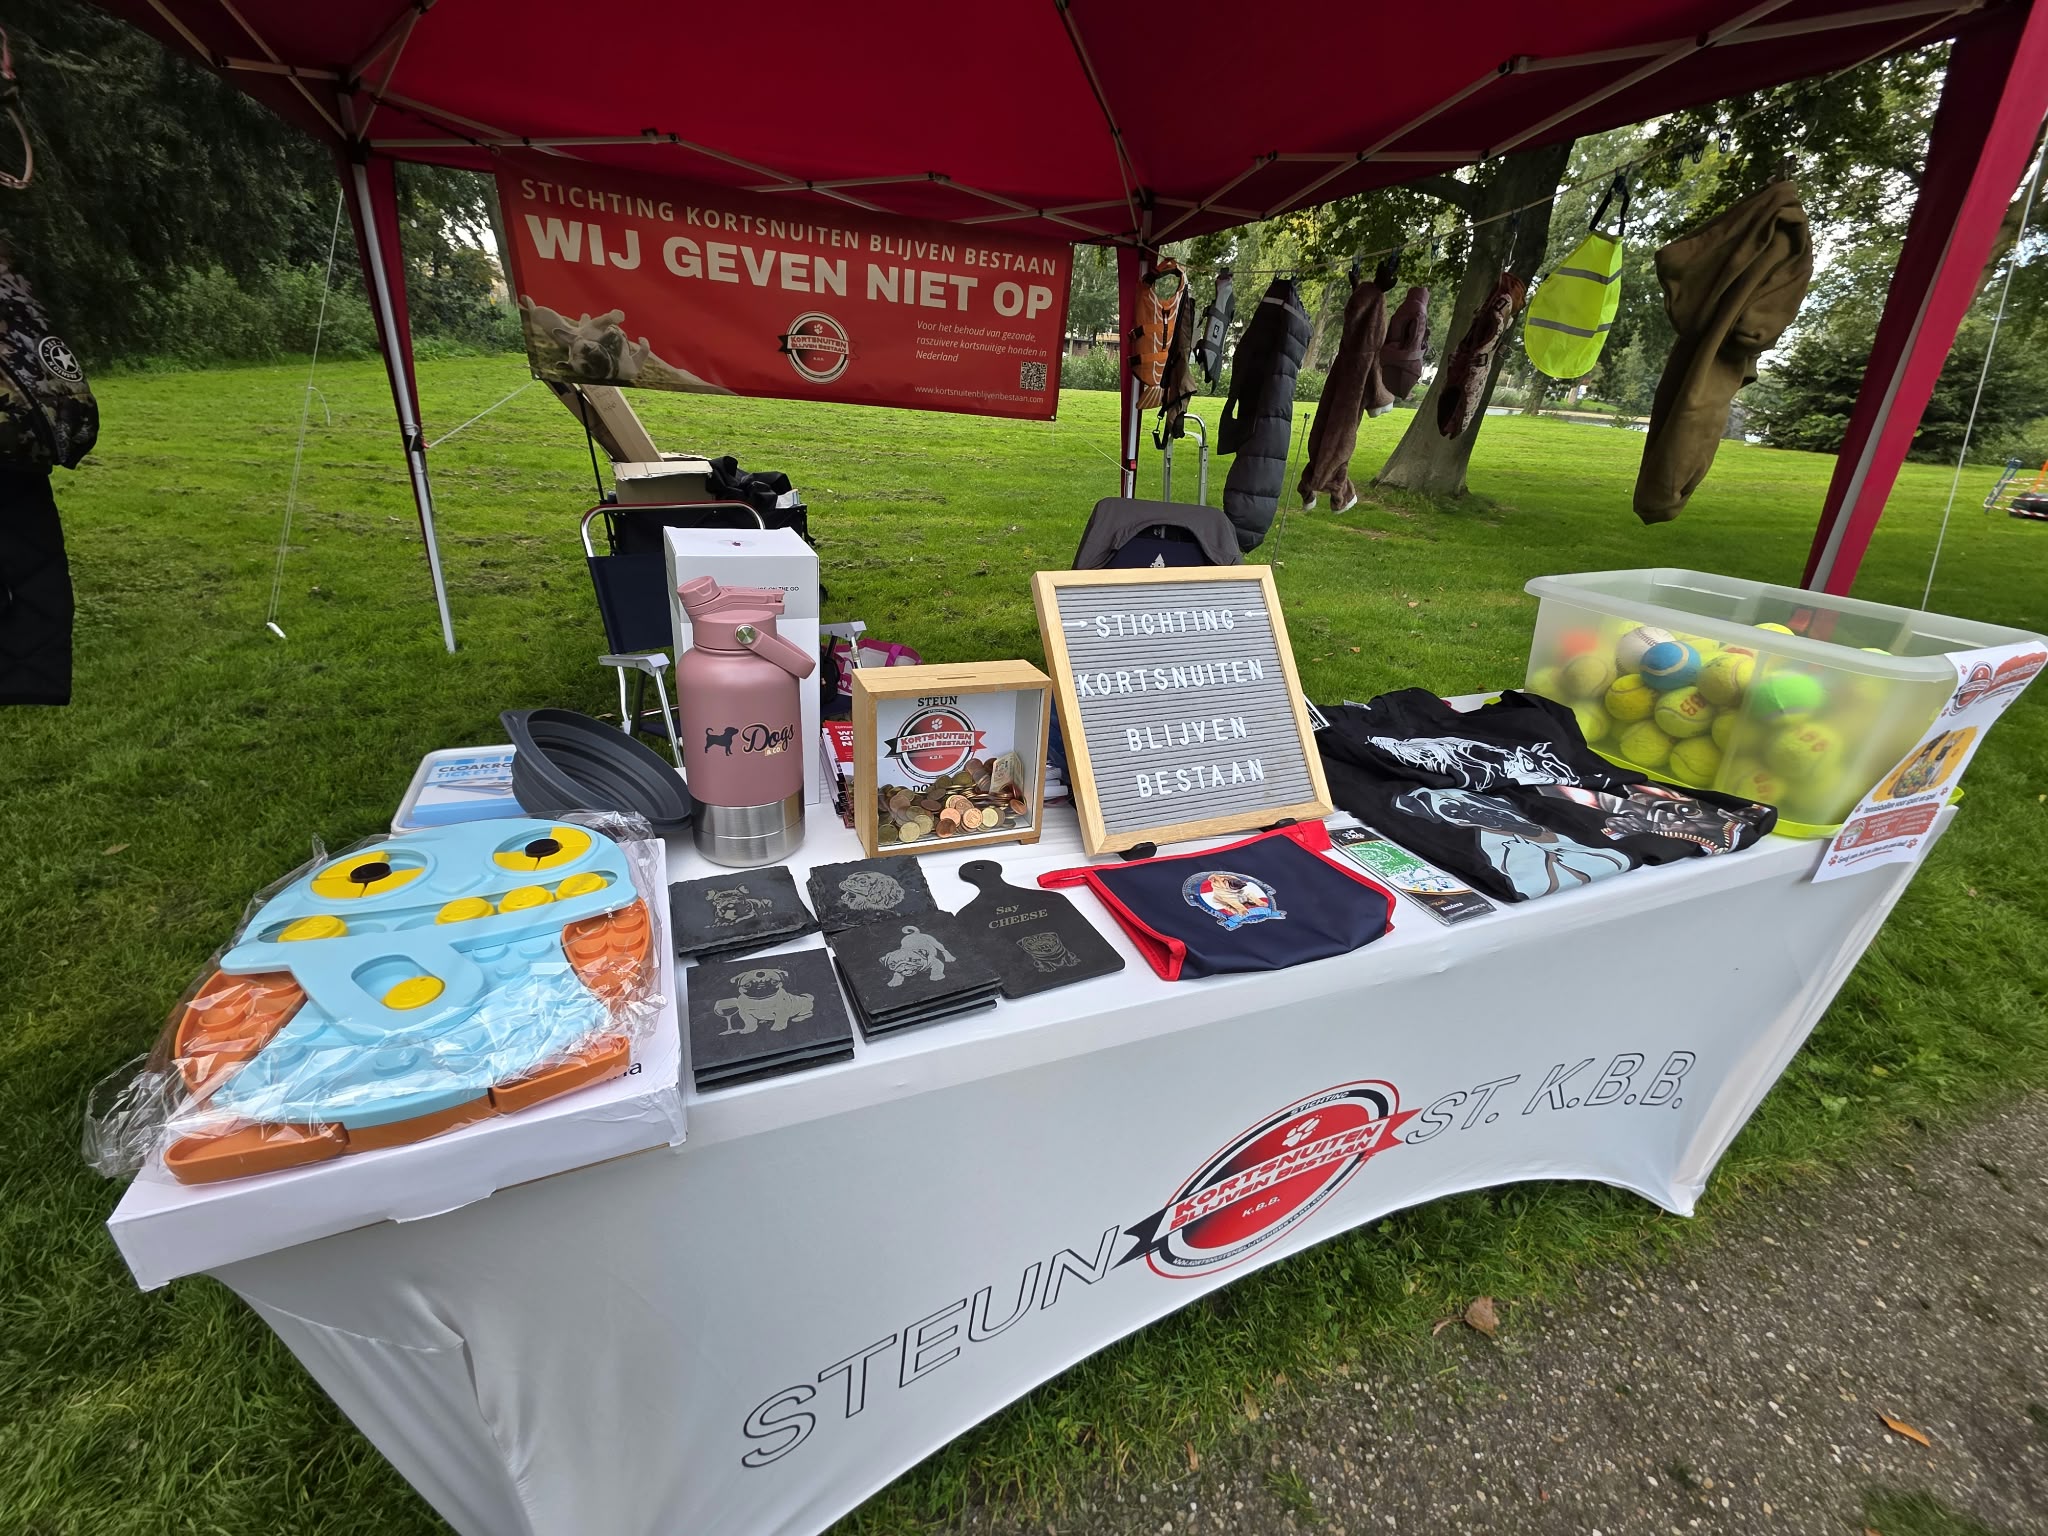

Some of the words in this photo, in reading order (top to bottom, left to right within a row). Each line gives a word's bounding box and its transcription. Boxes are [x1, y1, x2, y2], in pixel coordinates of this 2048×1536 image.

[520, 178, 674, 222] STICHTING
[687, 206, 859, 249] KORTSNUITEN
[870, 234, 956, 263] BLIJVEN
[965, 248, 1056, 276] BESTAAN
[524, 214, 642, 270] WIJ
[662, 236, 847, 297] GEVEN
[867, 263, 978, 311] NIET
[993, 281, 1053, 319] OP
[917, 320, 937, 331] Voor
[938, 322, 952, 333] het
[954, 324, 985, 336] behoud
[986, 330, 1001, 338] van
[1001, 331, 1036, 343] gezonde,
[916, 337, 959, 348] raszuivere
[960, 340, 1007, 354] kortsnuitige
[1007, 345, 1038, 357] honden
[1038, 348, 1047, 357] in
[916, 350, 959, 362] Nederland
[914, 386, 1044, 404] www.kortsnuitenblijvenbestaan.com
[1095, 609, 1235, 638] STICHTING
[1077, 659, 1264, 698] KORTSNUITEN
[917, 696, 958, 707] STEUN
[741, 724, 794, 753] Dogs
[900, 732, 973, 745] KORTSNUITEN
[1126, 716, 1248, 752] BLIJVEN
[901, 742, 935, 752] BLIJVEN
[437, 768, 499, 778] TICKETS
[1136, 759, 1266, 798] BESTAAN
[988, 909, 1048, 929] CHEESE
[996, 904, 1020, 915] Say
[1289, 1091, 1350, 1116] STICHTING
[1174, 1124, 1382, 1219] KORTSNUITEN
[1169, 1175, 1271, 1231] BLIJVEN
[1273, 1138, 1373, 1183] BESTAAN
[1242, 1197, 1281, 1218] K.B.B.
[741, 1224, 1120, 1468] STEUN
[1405, 1074, 1521, 1145] ST.
[1522, 1050, 1696, 1116] K.B.B.
